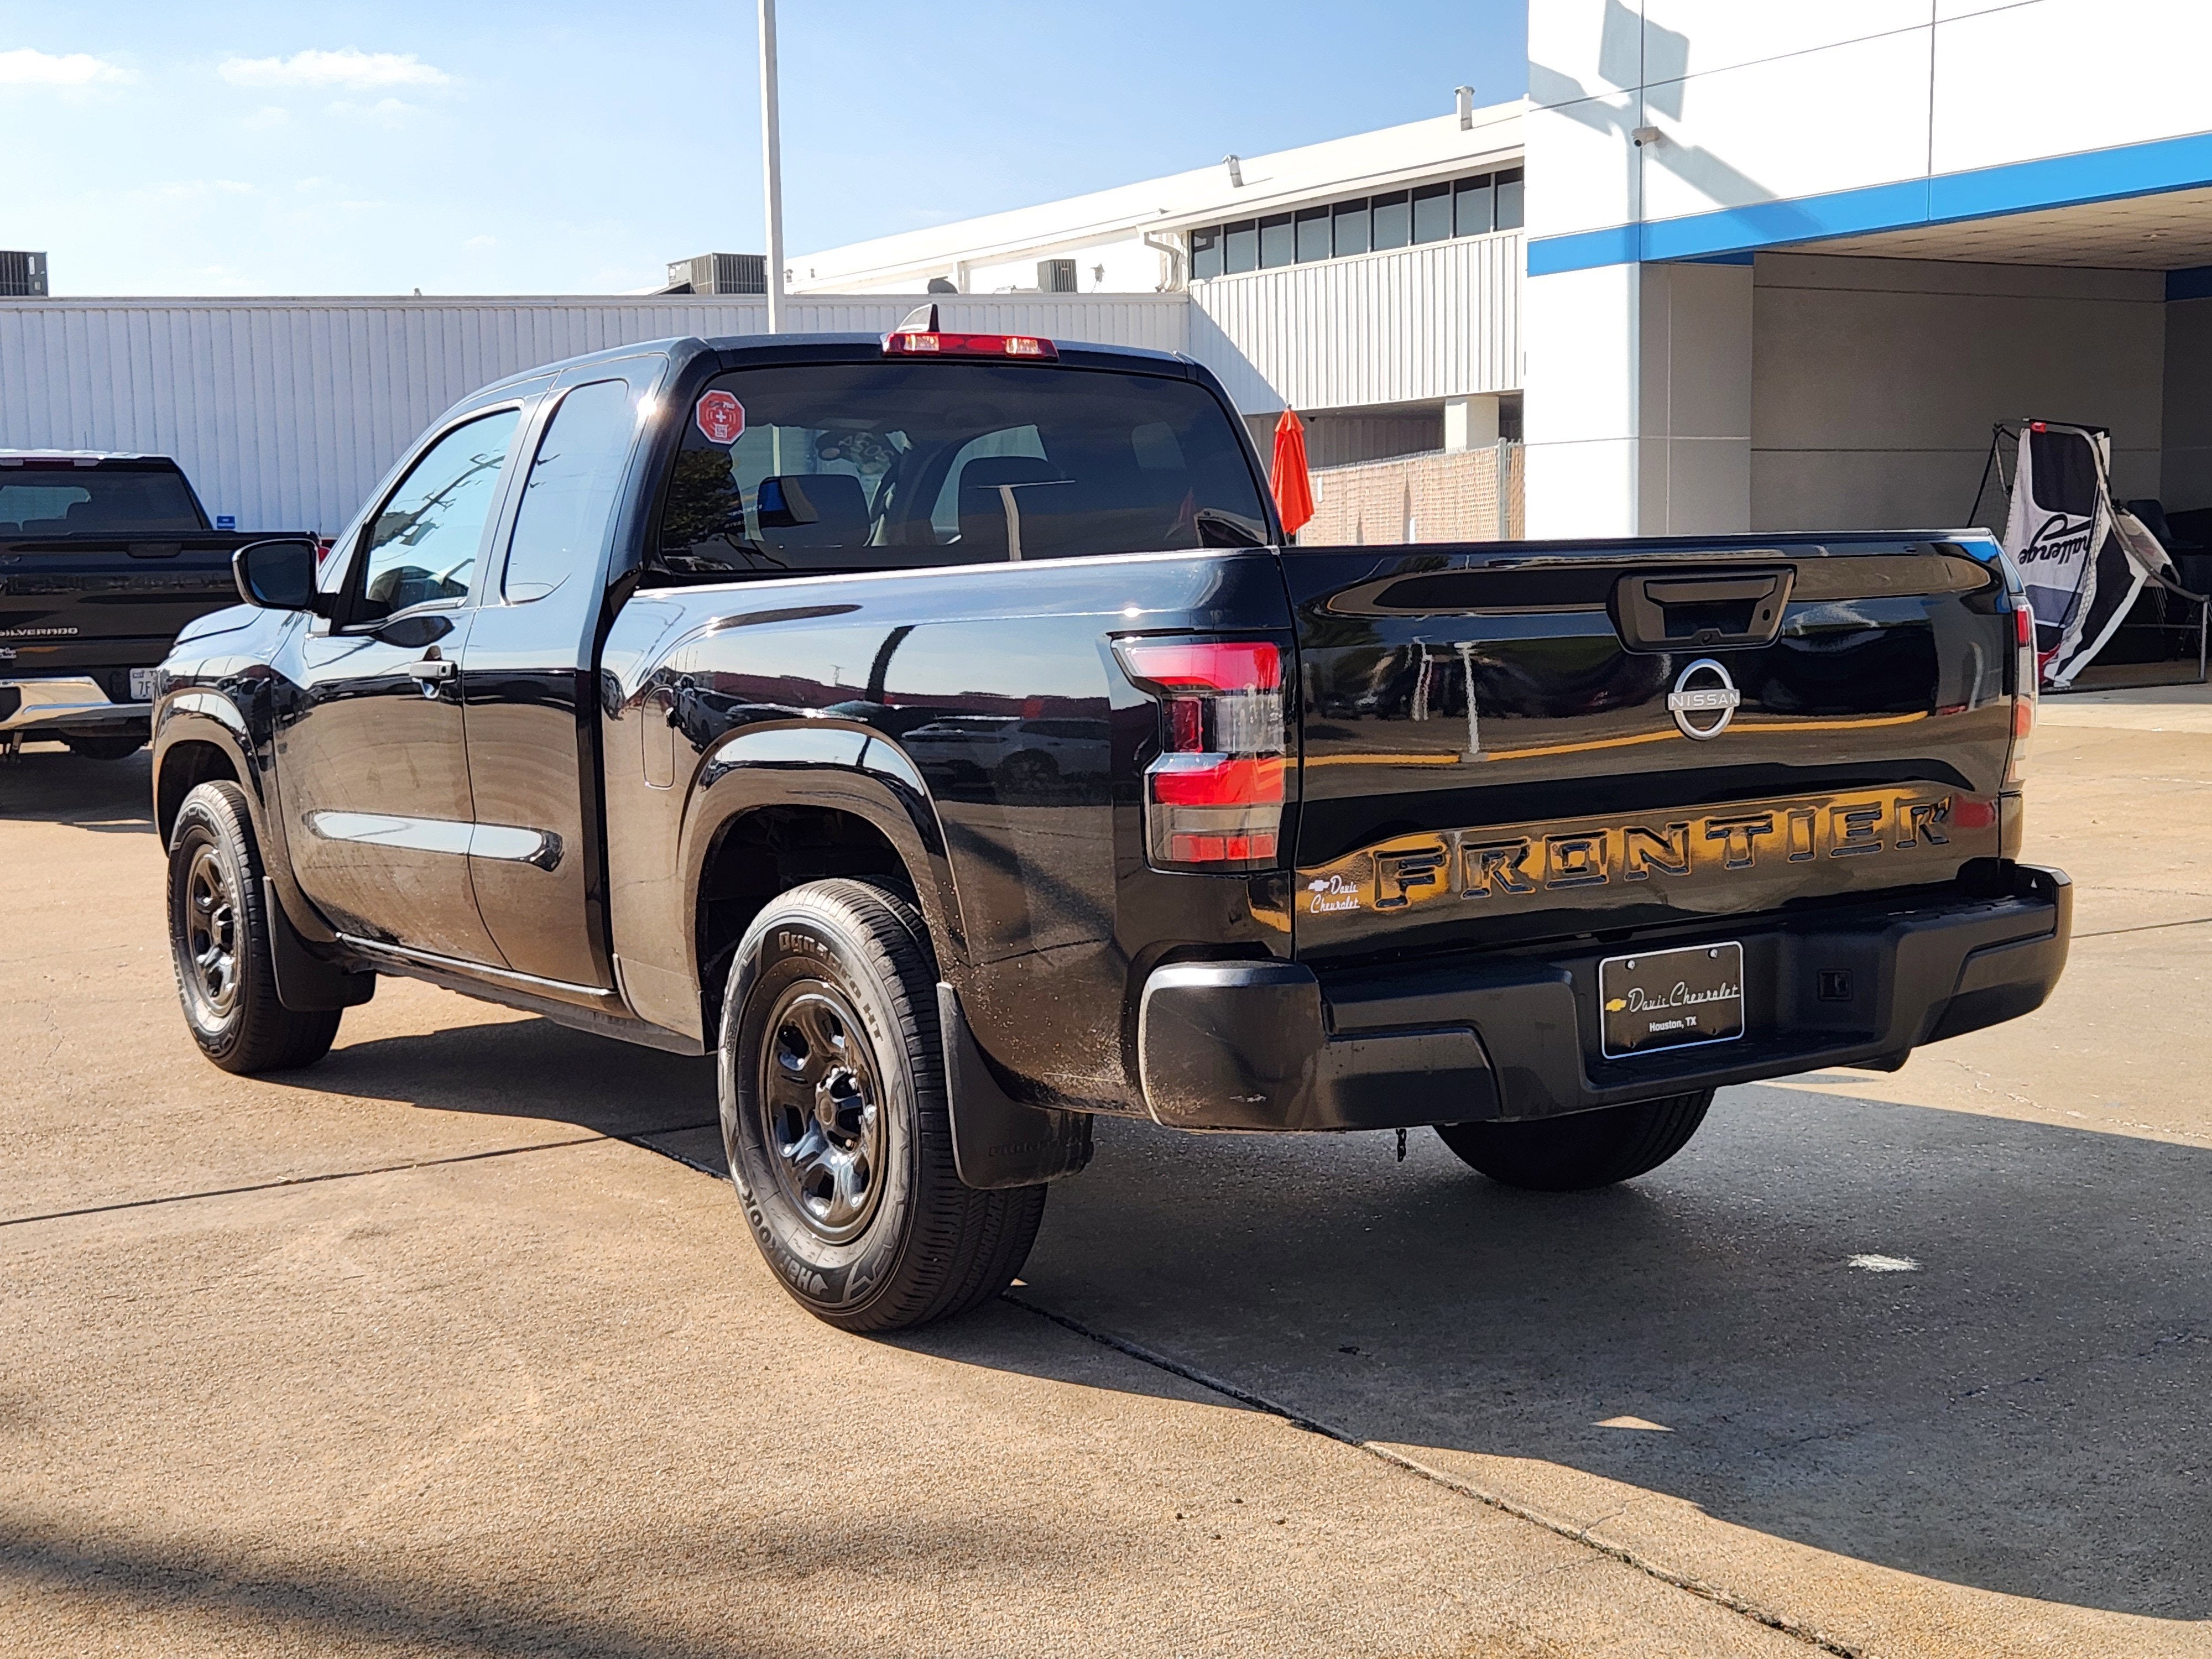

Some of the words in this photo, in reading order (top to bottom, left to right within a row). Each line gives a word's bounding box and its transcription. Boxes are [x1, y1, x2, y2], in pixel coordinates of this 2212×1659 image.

[1671, 693, 1738, 707] NISSAN
[1373, 795, 1952, 910] FRONTIER
[1330, 875, 1359, 895] Davis
[1311, 894, 1360, 914] Chevrolet
[1628, 988, 1670, 1013] Davis
[1670, 982, 1740, 1006] Chevrolet
[1650, 1020, 1684, 1032] Houston,
[1685, 1016, 1697, 1027] TX
